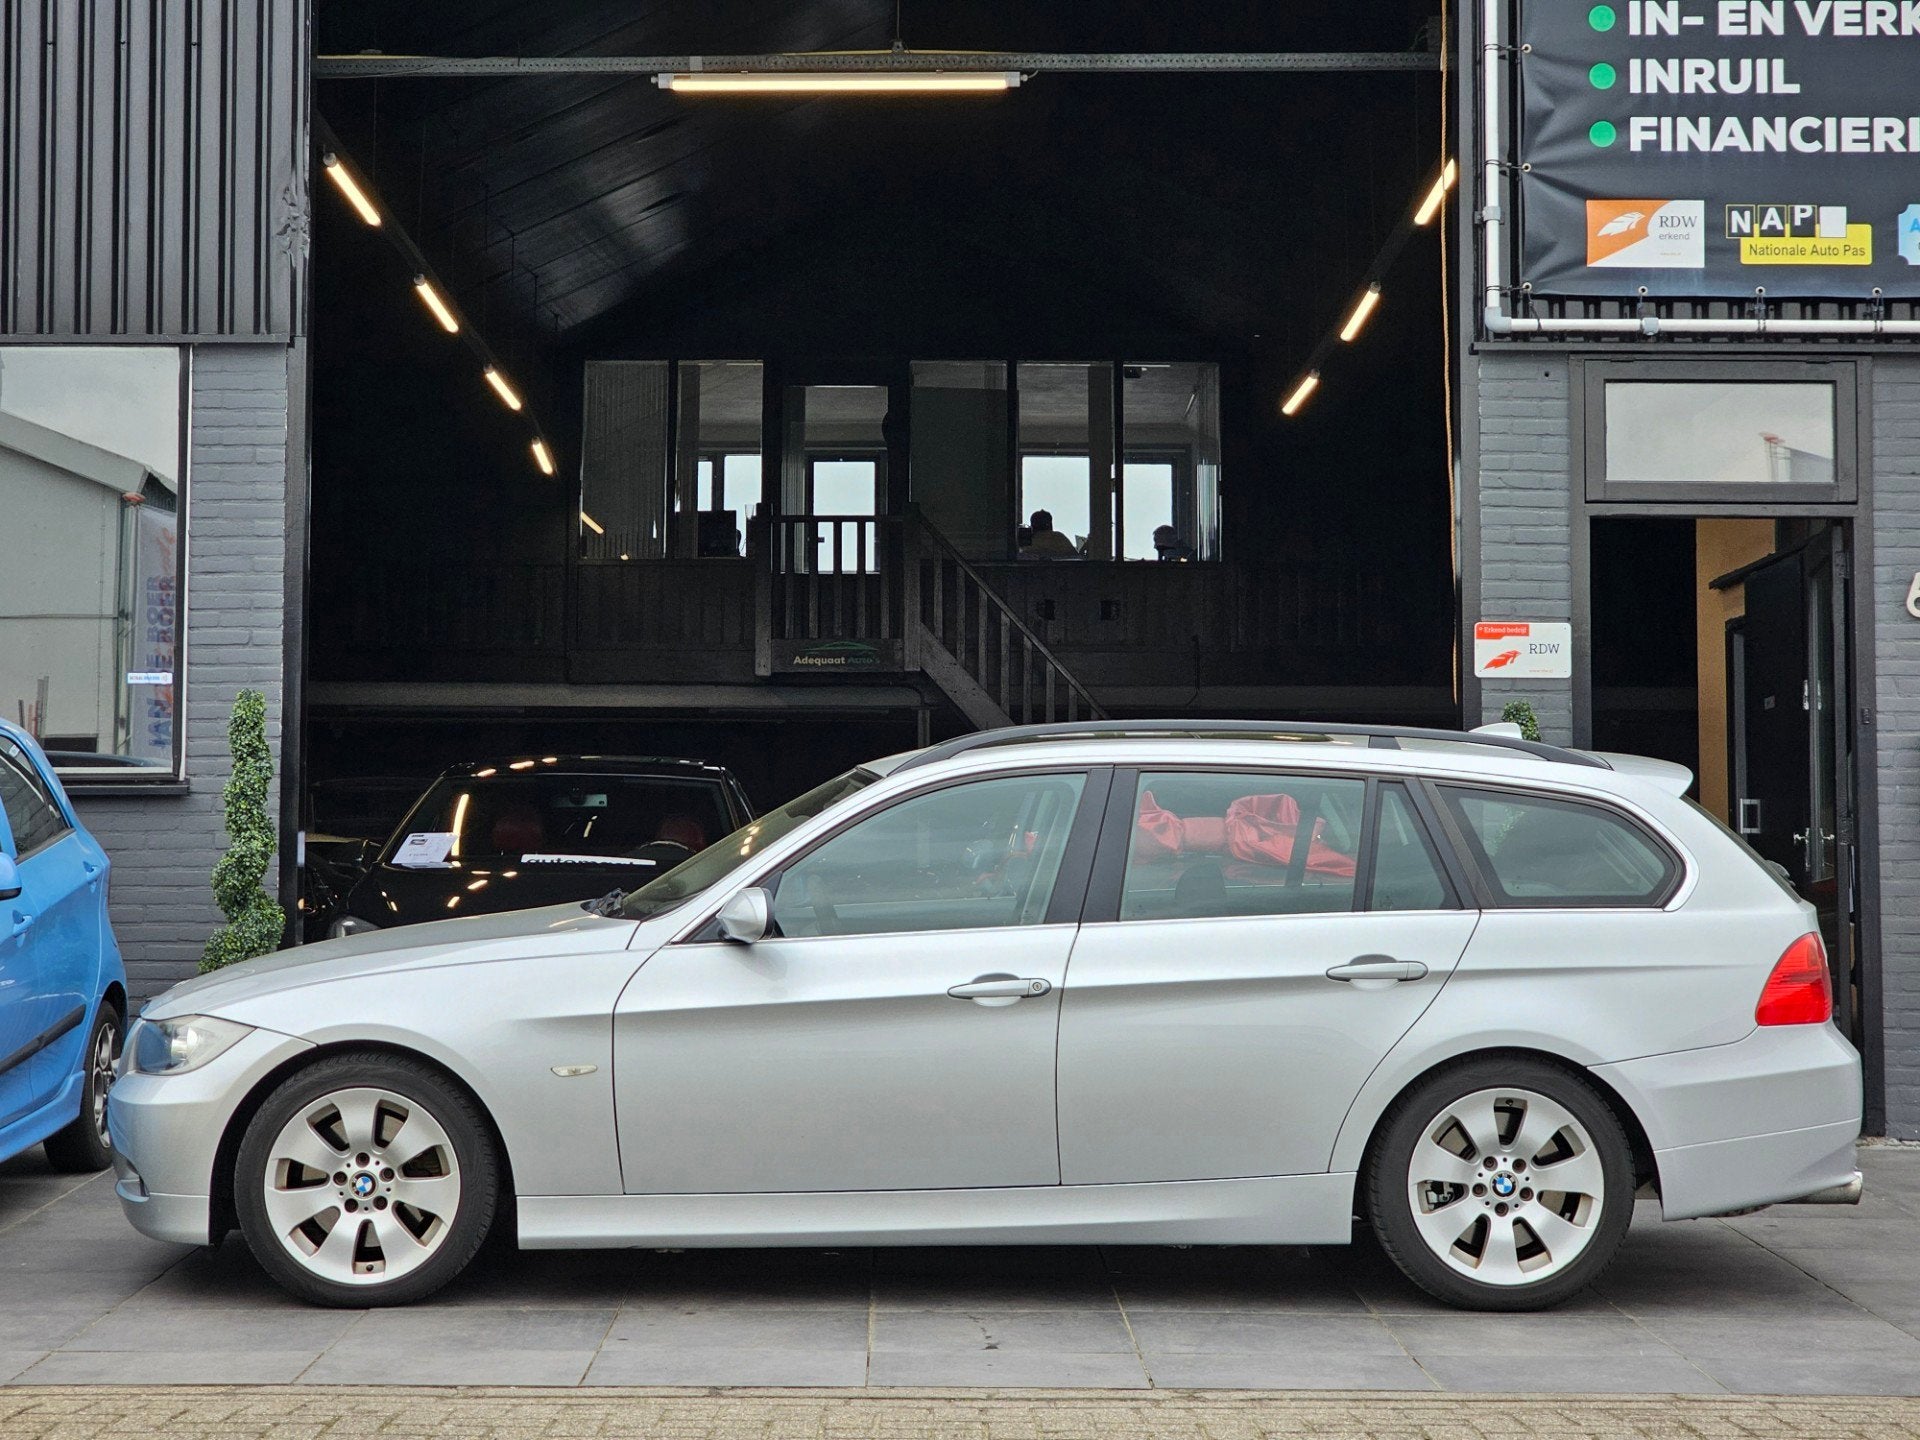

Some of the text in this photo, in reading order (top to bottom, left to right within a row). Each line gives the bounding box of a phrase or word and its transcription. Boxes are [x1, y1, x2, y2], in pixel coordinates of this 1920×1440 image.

[1629, 0, 1704, 36] IN-
[1718, 0, 1785, 36] EN
[1629, 58, 1801, 94] INRUIL
[1659, 215, 1698, 228] RDW
[1658, 232, 1690, 241] erkend
[1749, 244, 1866, 256] Nationale Auto Pas
[1529, 643, 1560, 655] RDW
[793, 655, 846, 666] Adequaat
